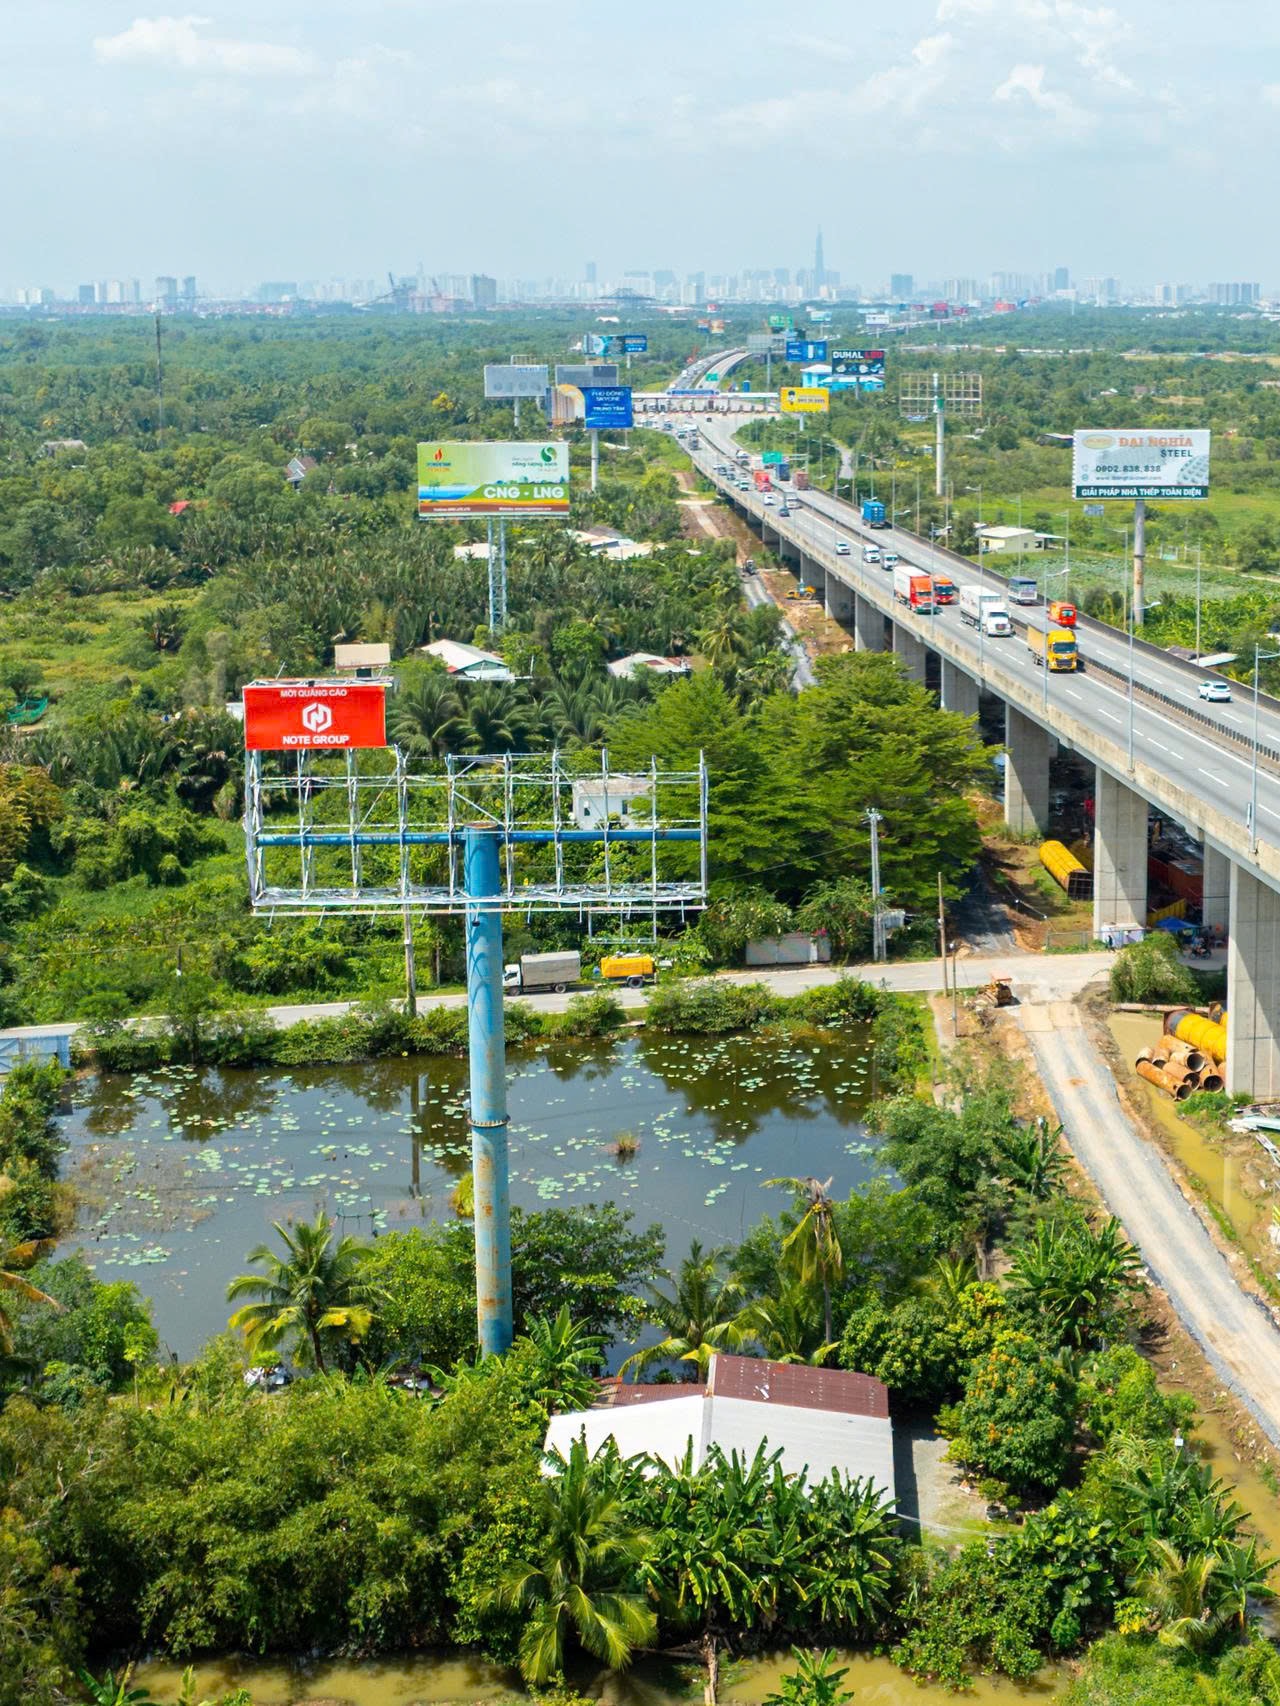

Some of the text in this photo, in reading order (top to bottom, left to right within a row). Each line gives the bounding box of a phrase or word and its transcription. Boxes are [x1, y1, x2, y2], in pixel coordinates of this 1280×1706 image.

[832, 351, 864, 359] DUHAL
[1160, 449, 1193, 458] STEEL
[483, 486, 520, 499] CNG
[533, 486, 564, 499] LNG
[1098, 488, 1121, 497] PHÁP
[1121, 488, 1139, 497] NHÀ
[1161, 488, 1182, 497] TOÀN
[283, 736, 349, 745] NOTE GROUP
